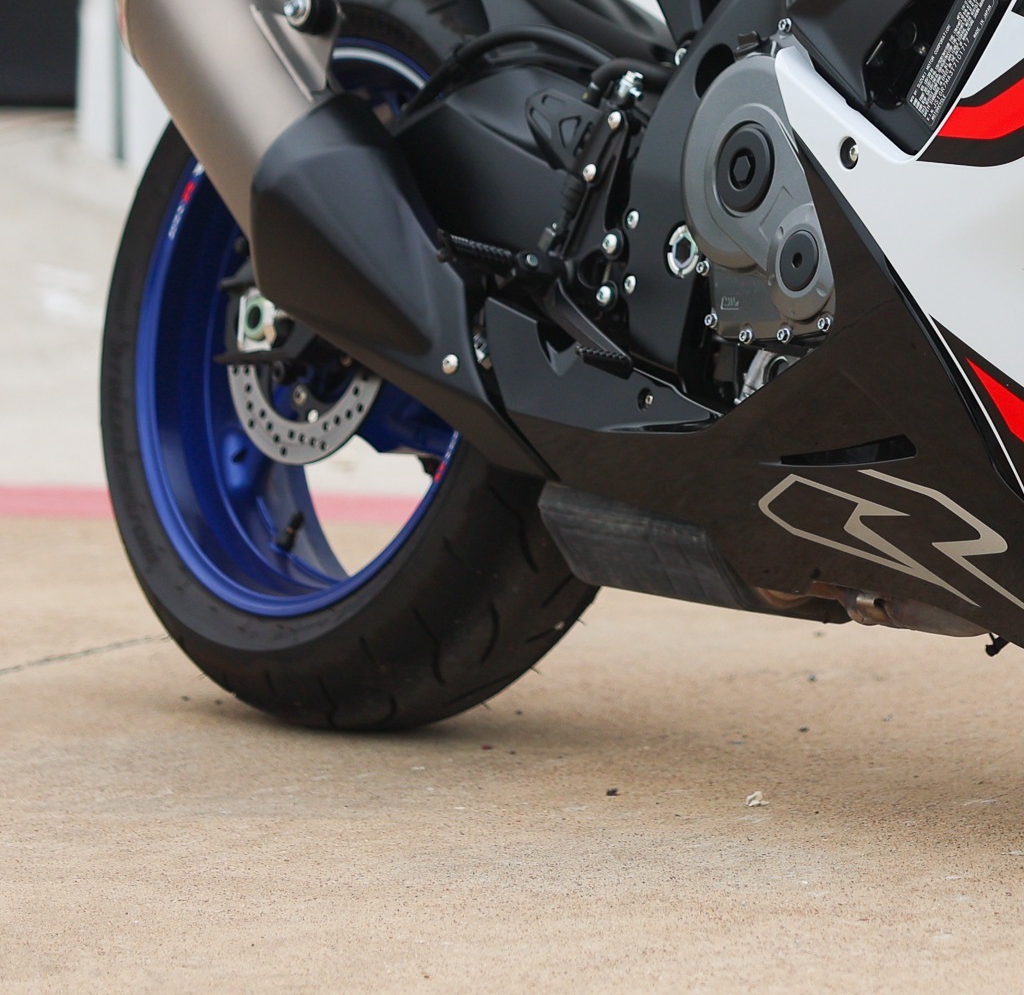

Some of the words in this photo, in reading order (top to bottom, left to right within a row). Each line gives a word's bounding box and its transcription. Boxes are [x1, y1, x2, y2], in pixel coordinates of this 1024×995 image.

[916, 71, 927, 90] SUZUKI
[925, 54, 936, 72] MOTOR
[933, 23, 952, 56] CORPORATION
